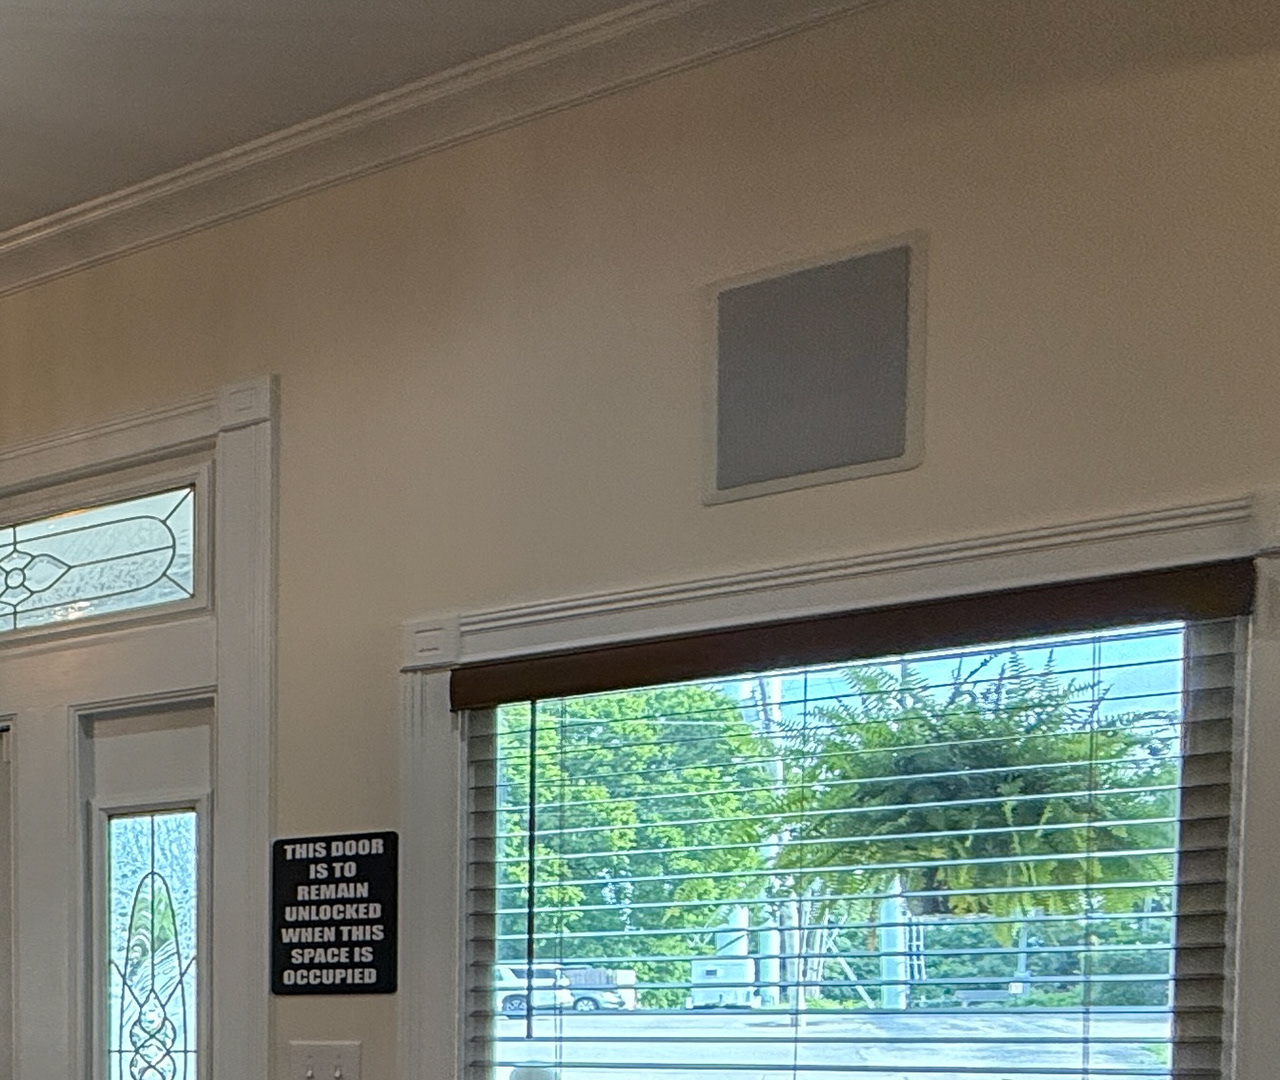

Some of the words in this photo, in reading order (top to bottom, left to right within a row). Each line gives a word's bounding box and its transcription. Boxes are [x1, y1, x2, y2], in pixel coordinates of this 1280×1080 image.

[283, 842, 327, 860] THIS
[331, 838, 384, 857] DOOR
[309, 863, 329, 879] IS
[332, 861, 357, 878] TO
[297, 882, 369, 901] REMAIN
[284, 903, 382, 922] UNLOCKED
[281, 926, 336, 943] WHEN
[339, 924, 385, 941] THIS
[291, 948, 350, 964] SPACE
[353, 946, 374, 962] IS
[283, 968, 377, 985] OCCUPIED
